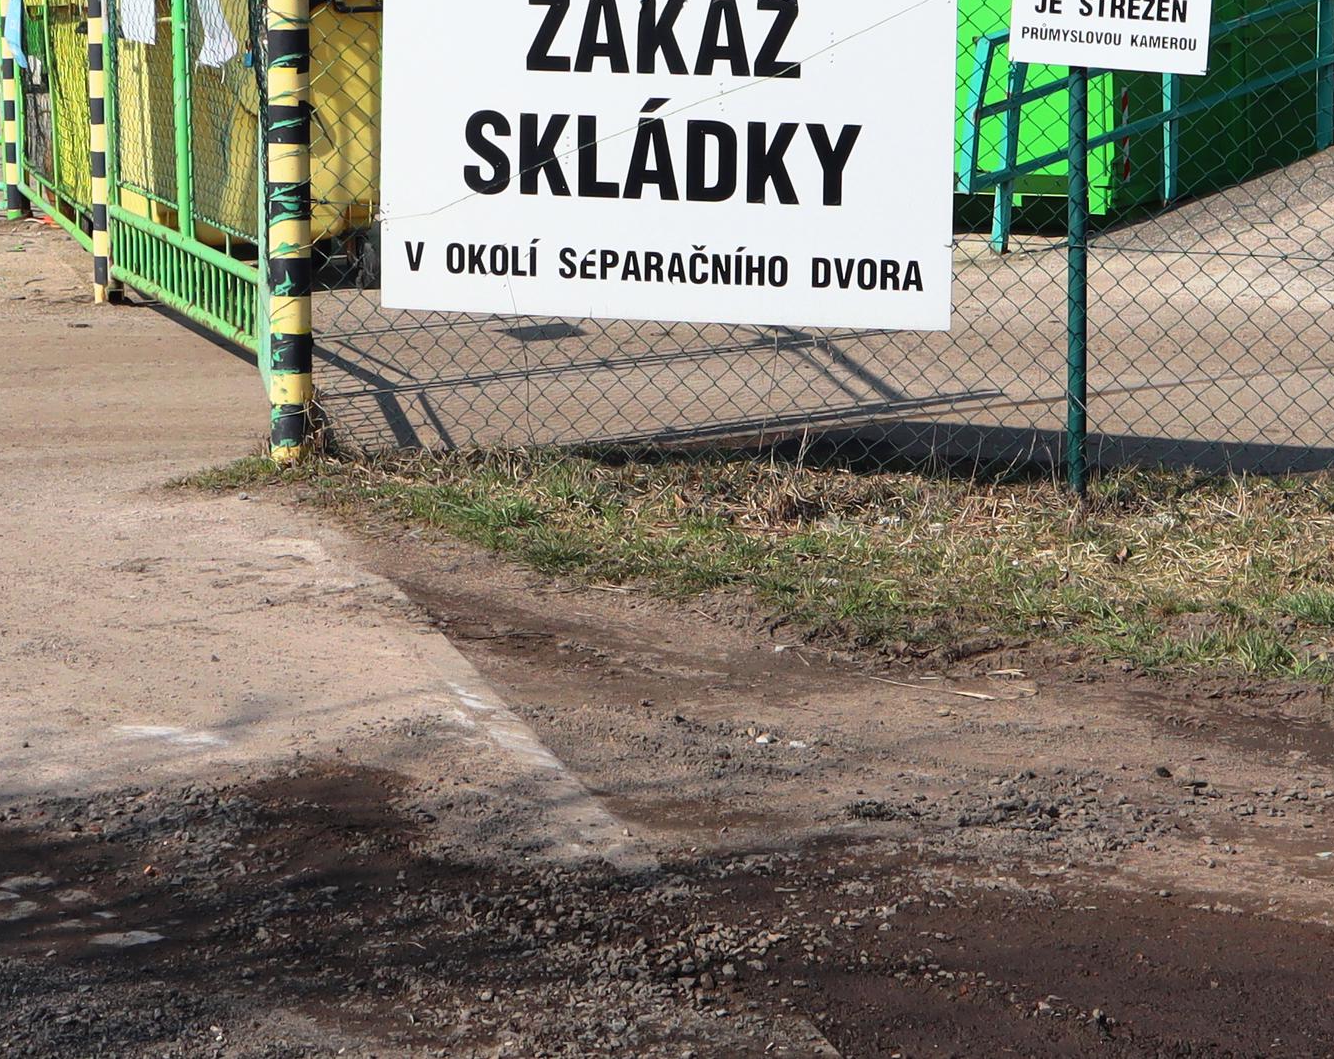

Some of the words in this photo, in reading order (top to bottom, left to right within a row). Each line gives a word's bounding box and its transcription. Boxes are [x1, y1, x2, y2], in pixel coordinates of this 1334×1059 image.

[1022, 23, 1121, 45] PRŮMYSLOVOU
[1131, 35, 1196, 51] KAMEROU
[464, 98, 860, 206] SKLÁDKY
[405, 241, 424, 271] V
[447, 238, 538, 276] OKOLÍ
[559, 245, 788, 287] SEPARAČNÍHO
[812, 258, 923, 291] DVORA
